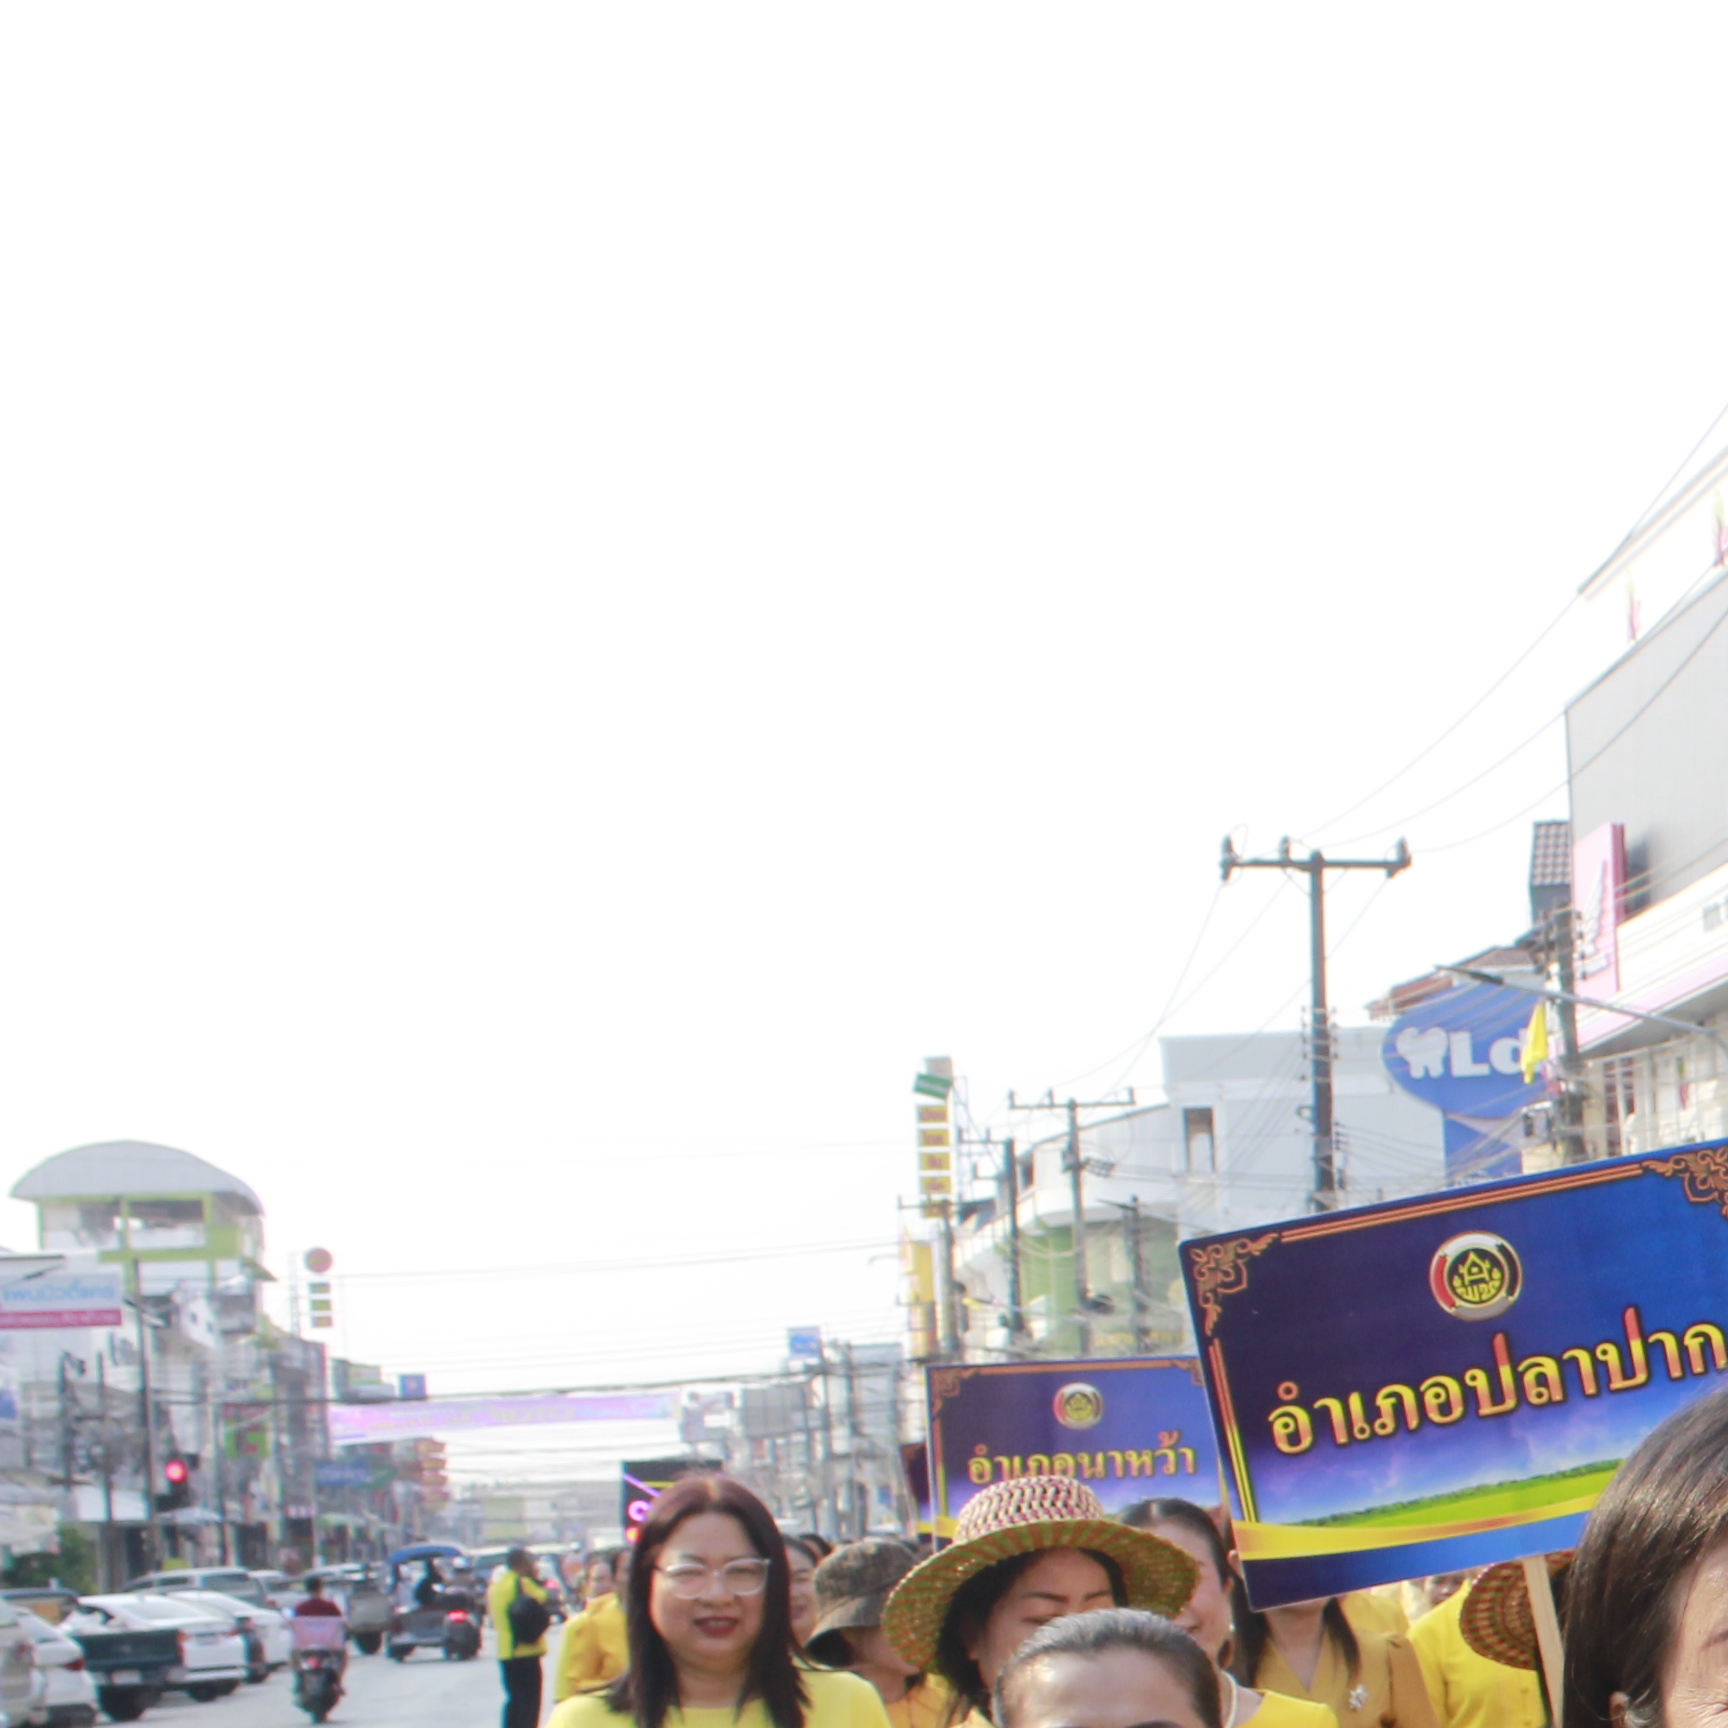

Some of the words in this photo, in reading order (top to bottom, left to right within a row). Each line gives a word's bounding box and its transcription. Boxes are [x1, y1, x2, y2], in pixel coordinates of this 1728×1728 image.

[967, 1430, 1196, 1485] อำเภอนาหว้า
